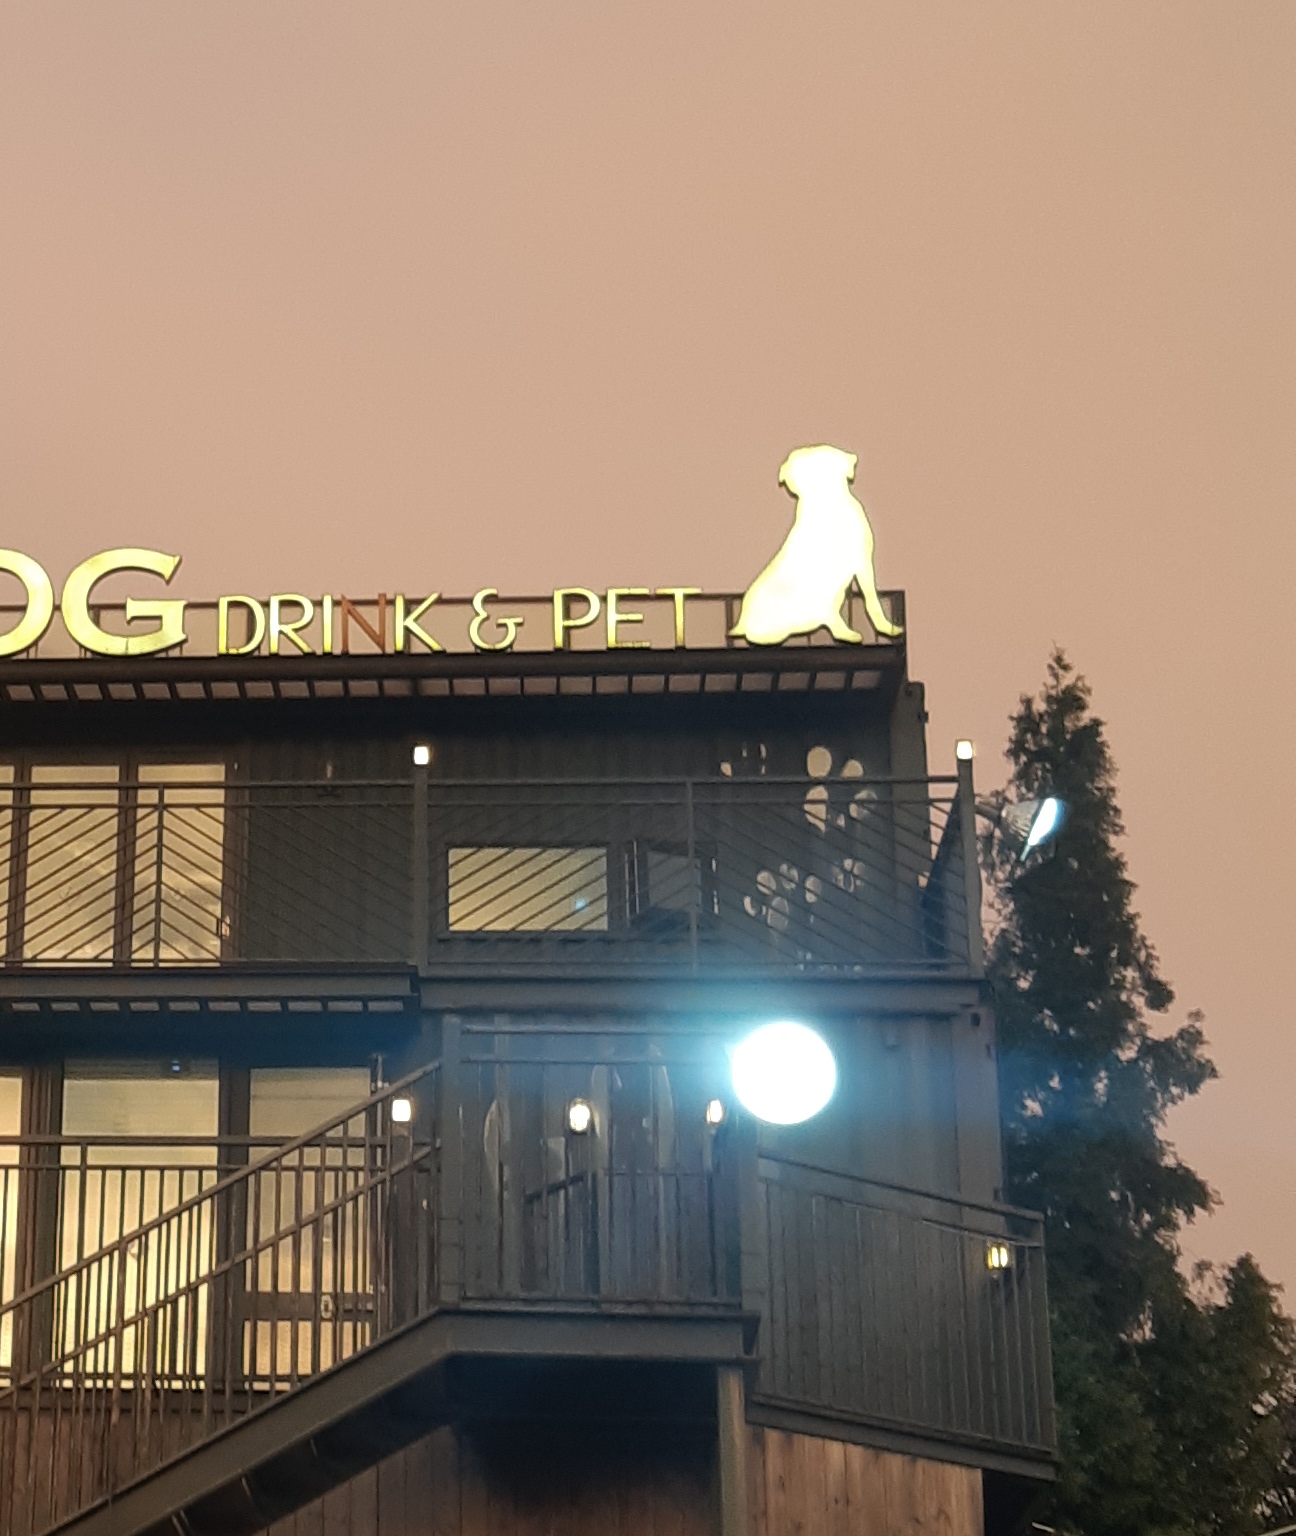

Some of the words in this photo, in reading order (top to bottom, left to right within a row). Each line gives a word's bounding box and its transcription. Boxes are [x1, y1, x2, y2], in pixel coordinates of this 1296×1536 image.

[217, 592, 444, 655] DRINK
[469, 587, 524, 650] &
[552, 586, 702, 650] PET
